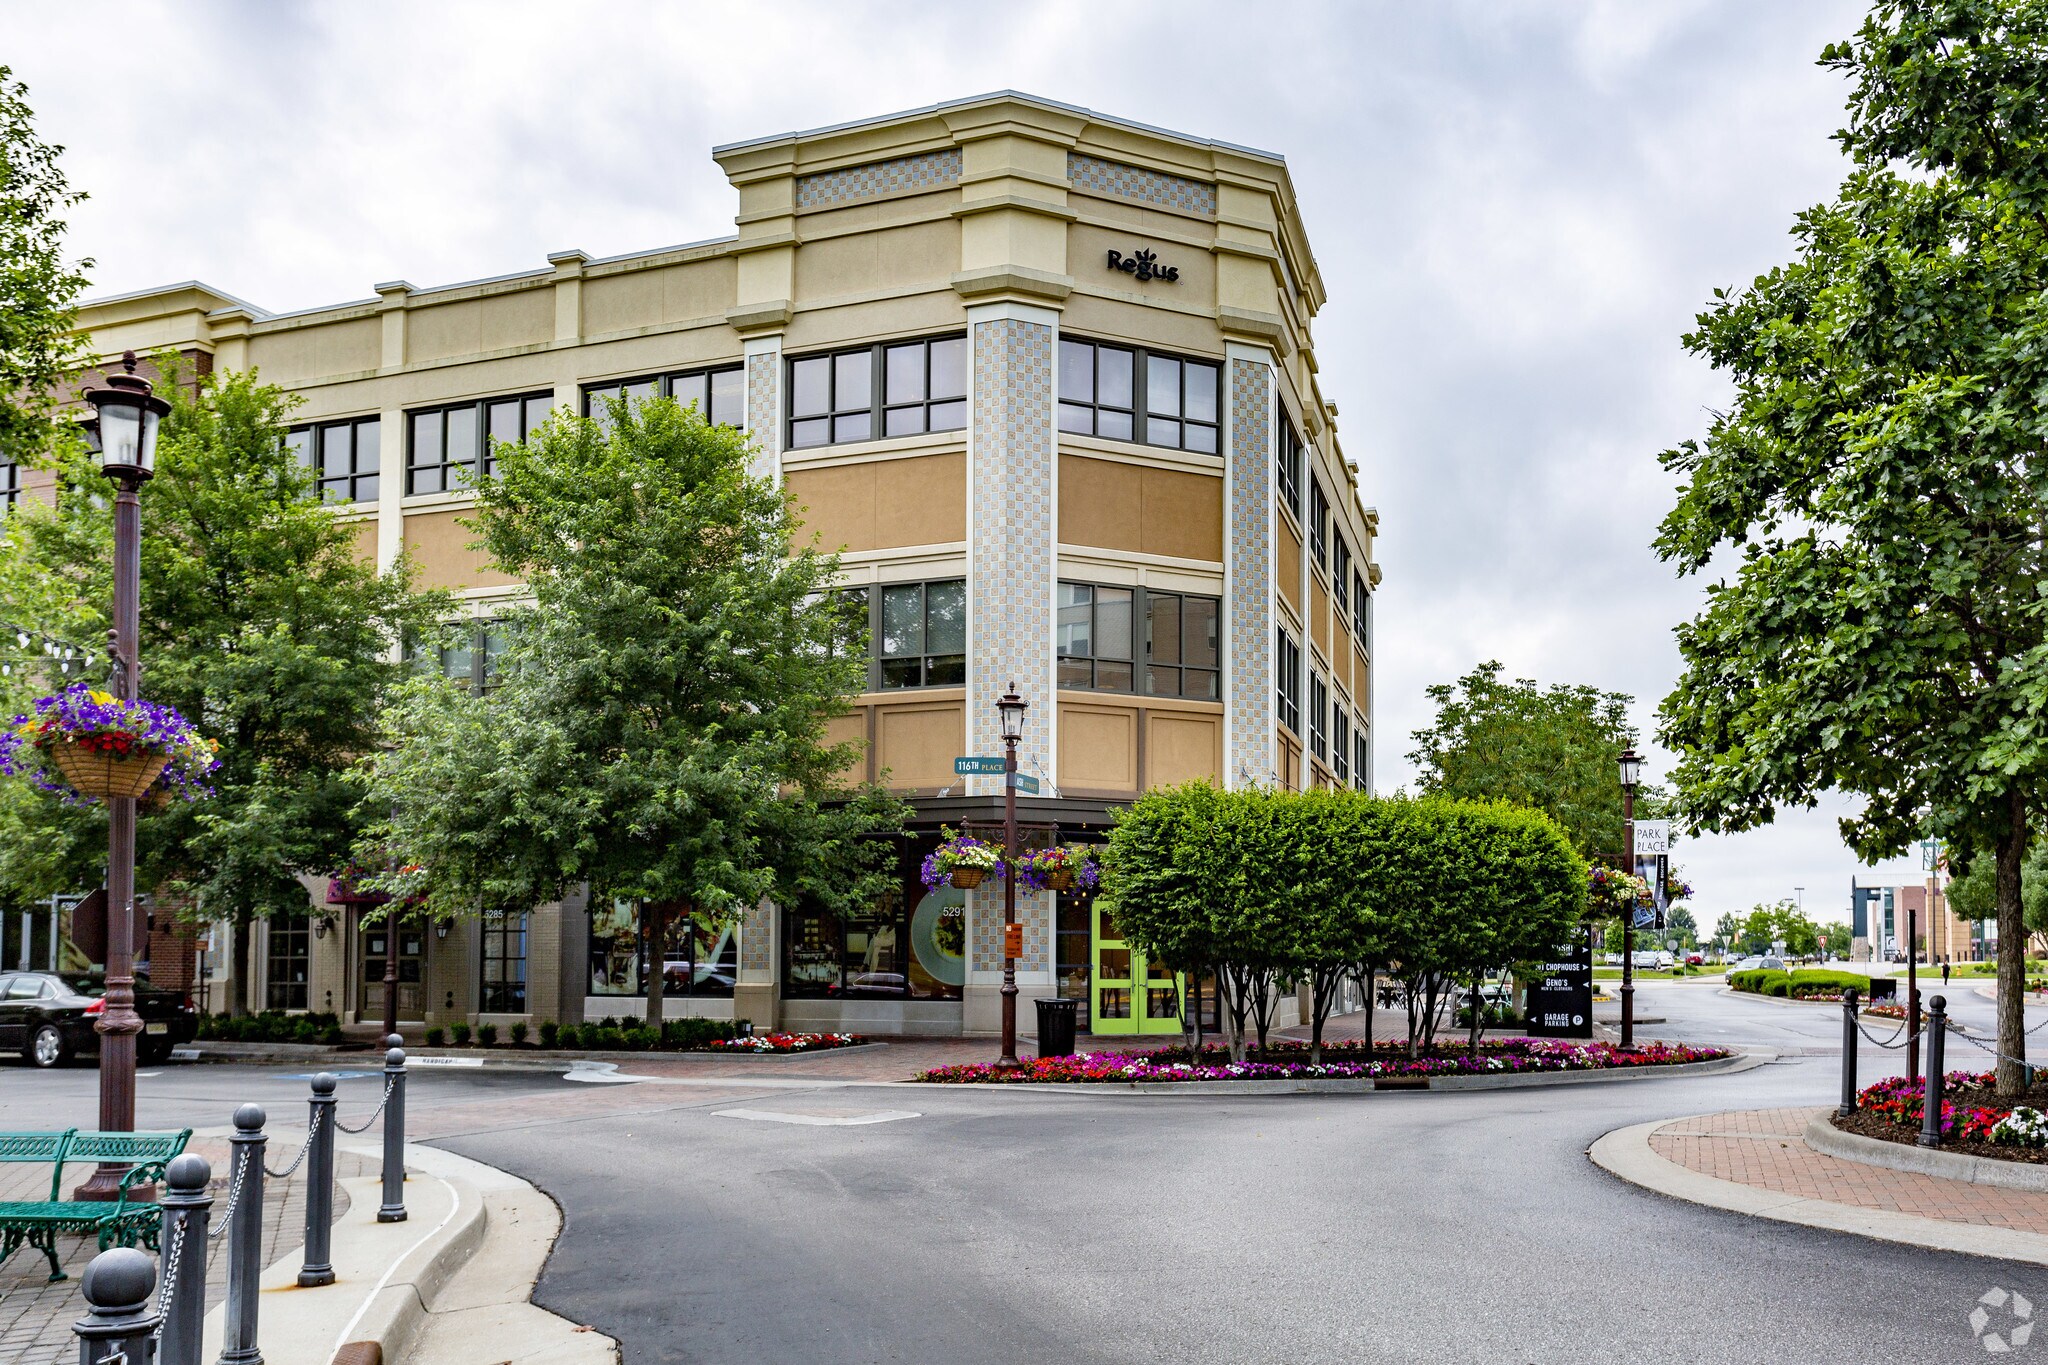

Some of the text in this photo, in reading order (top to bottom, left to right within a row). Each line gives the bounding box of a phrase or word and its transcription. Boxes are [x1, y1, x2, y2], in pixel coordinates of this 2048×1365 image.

[1107, 248, 1179, 281] Regus
[958, 761, 979, 770] 116TH
[1637, 829, 1661, 839] PARK
[1637, 841, 1665, 852] PLACE
[943, 906, 965, 917] 5291
[1545, 963, 1580, 971] CHOPHOUSE
